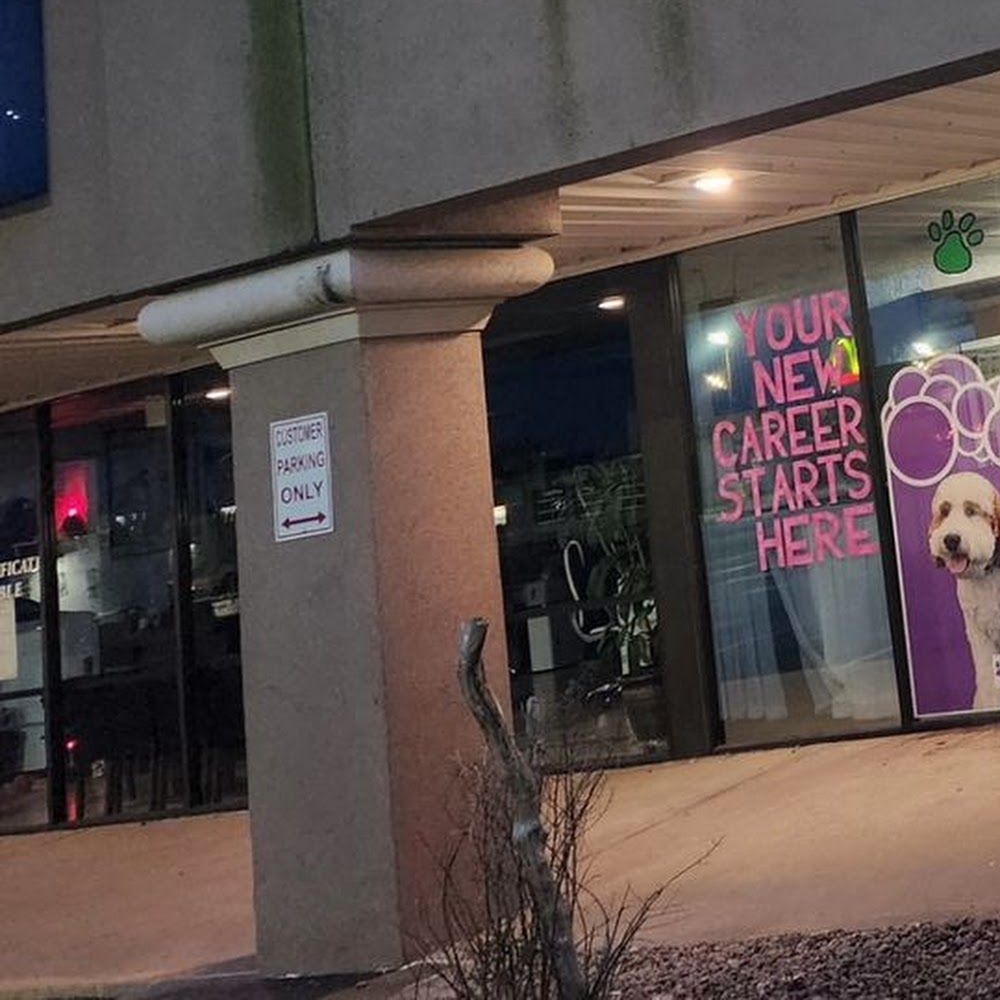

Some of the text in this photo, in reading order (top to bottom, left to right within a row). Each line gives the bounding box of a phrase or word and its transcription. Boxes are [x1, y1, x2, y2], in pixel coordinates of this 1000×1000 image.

[733, 290, 853, 357] YOUR
[753, 349, 845, 408] NEW
[276, 421, 324, 447] CUSTOMER
[277, 451, 326, 476] PARKING
[712, 396, 866, 469] CAREER
[280, 481, 324, 504] ONLY
[716, 451, 873, 523] STARTS
[755, 502, 881, 571] HERE
